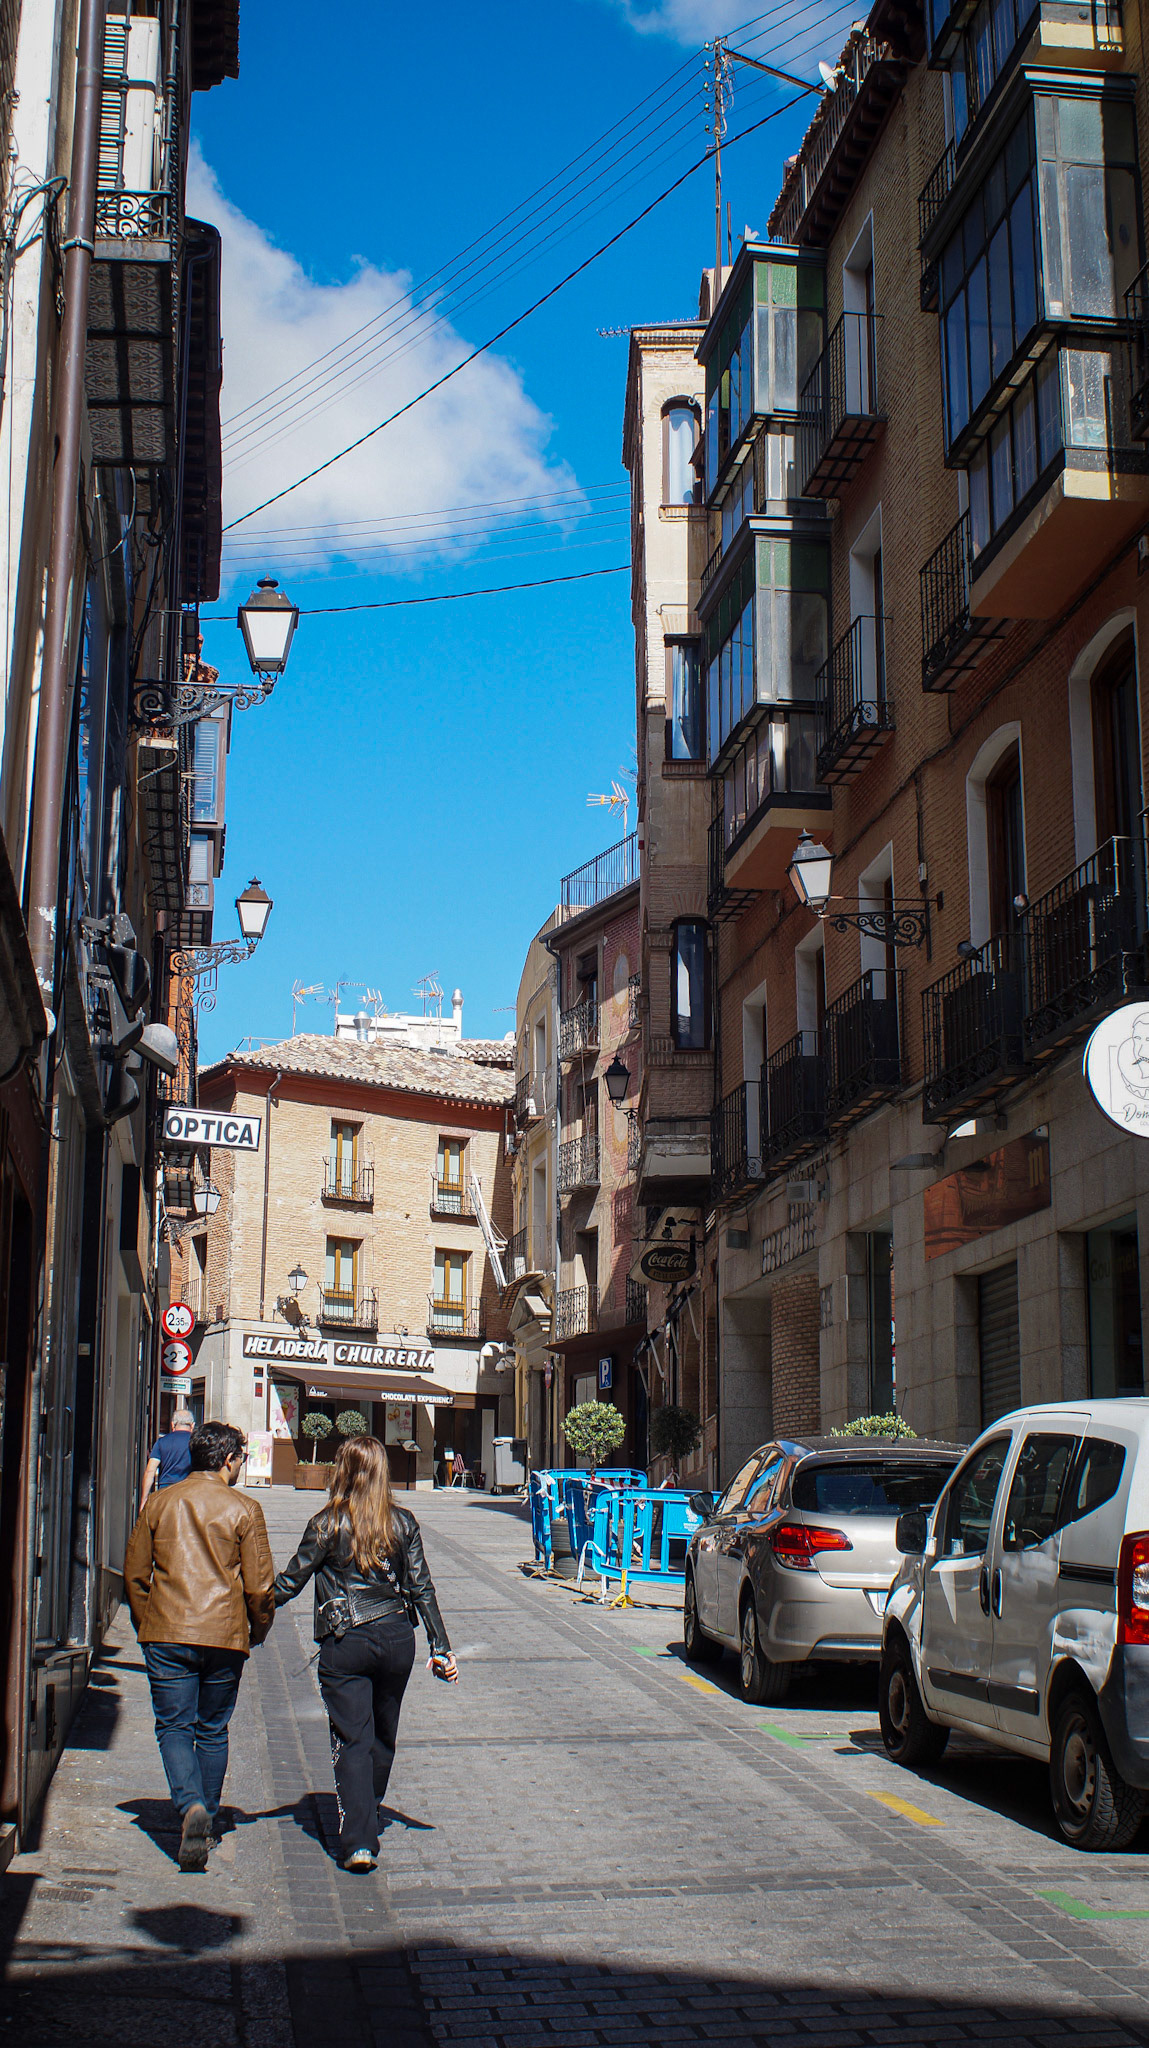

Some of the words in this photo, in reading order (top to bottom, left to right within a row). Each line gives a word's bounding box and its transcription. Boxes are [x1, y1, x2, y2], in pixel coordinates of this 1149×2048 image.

[166, 1112, 254, 1145] ÓPTICA
[244, 1336, 328, 1360] HELADERÍA
[335, 1345, 435, 1369] CHURRERÍA
[602, 1360, 609, 1385] P
[381, 1392, 416, 1402] CHOCOLATE
[417, 1394, 453, 1404] EXPERIENCE
